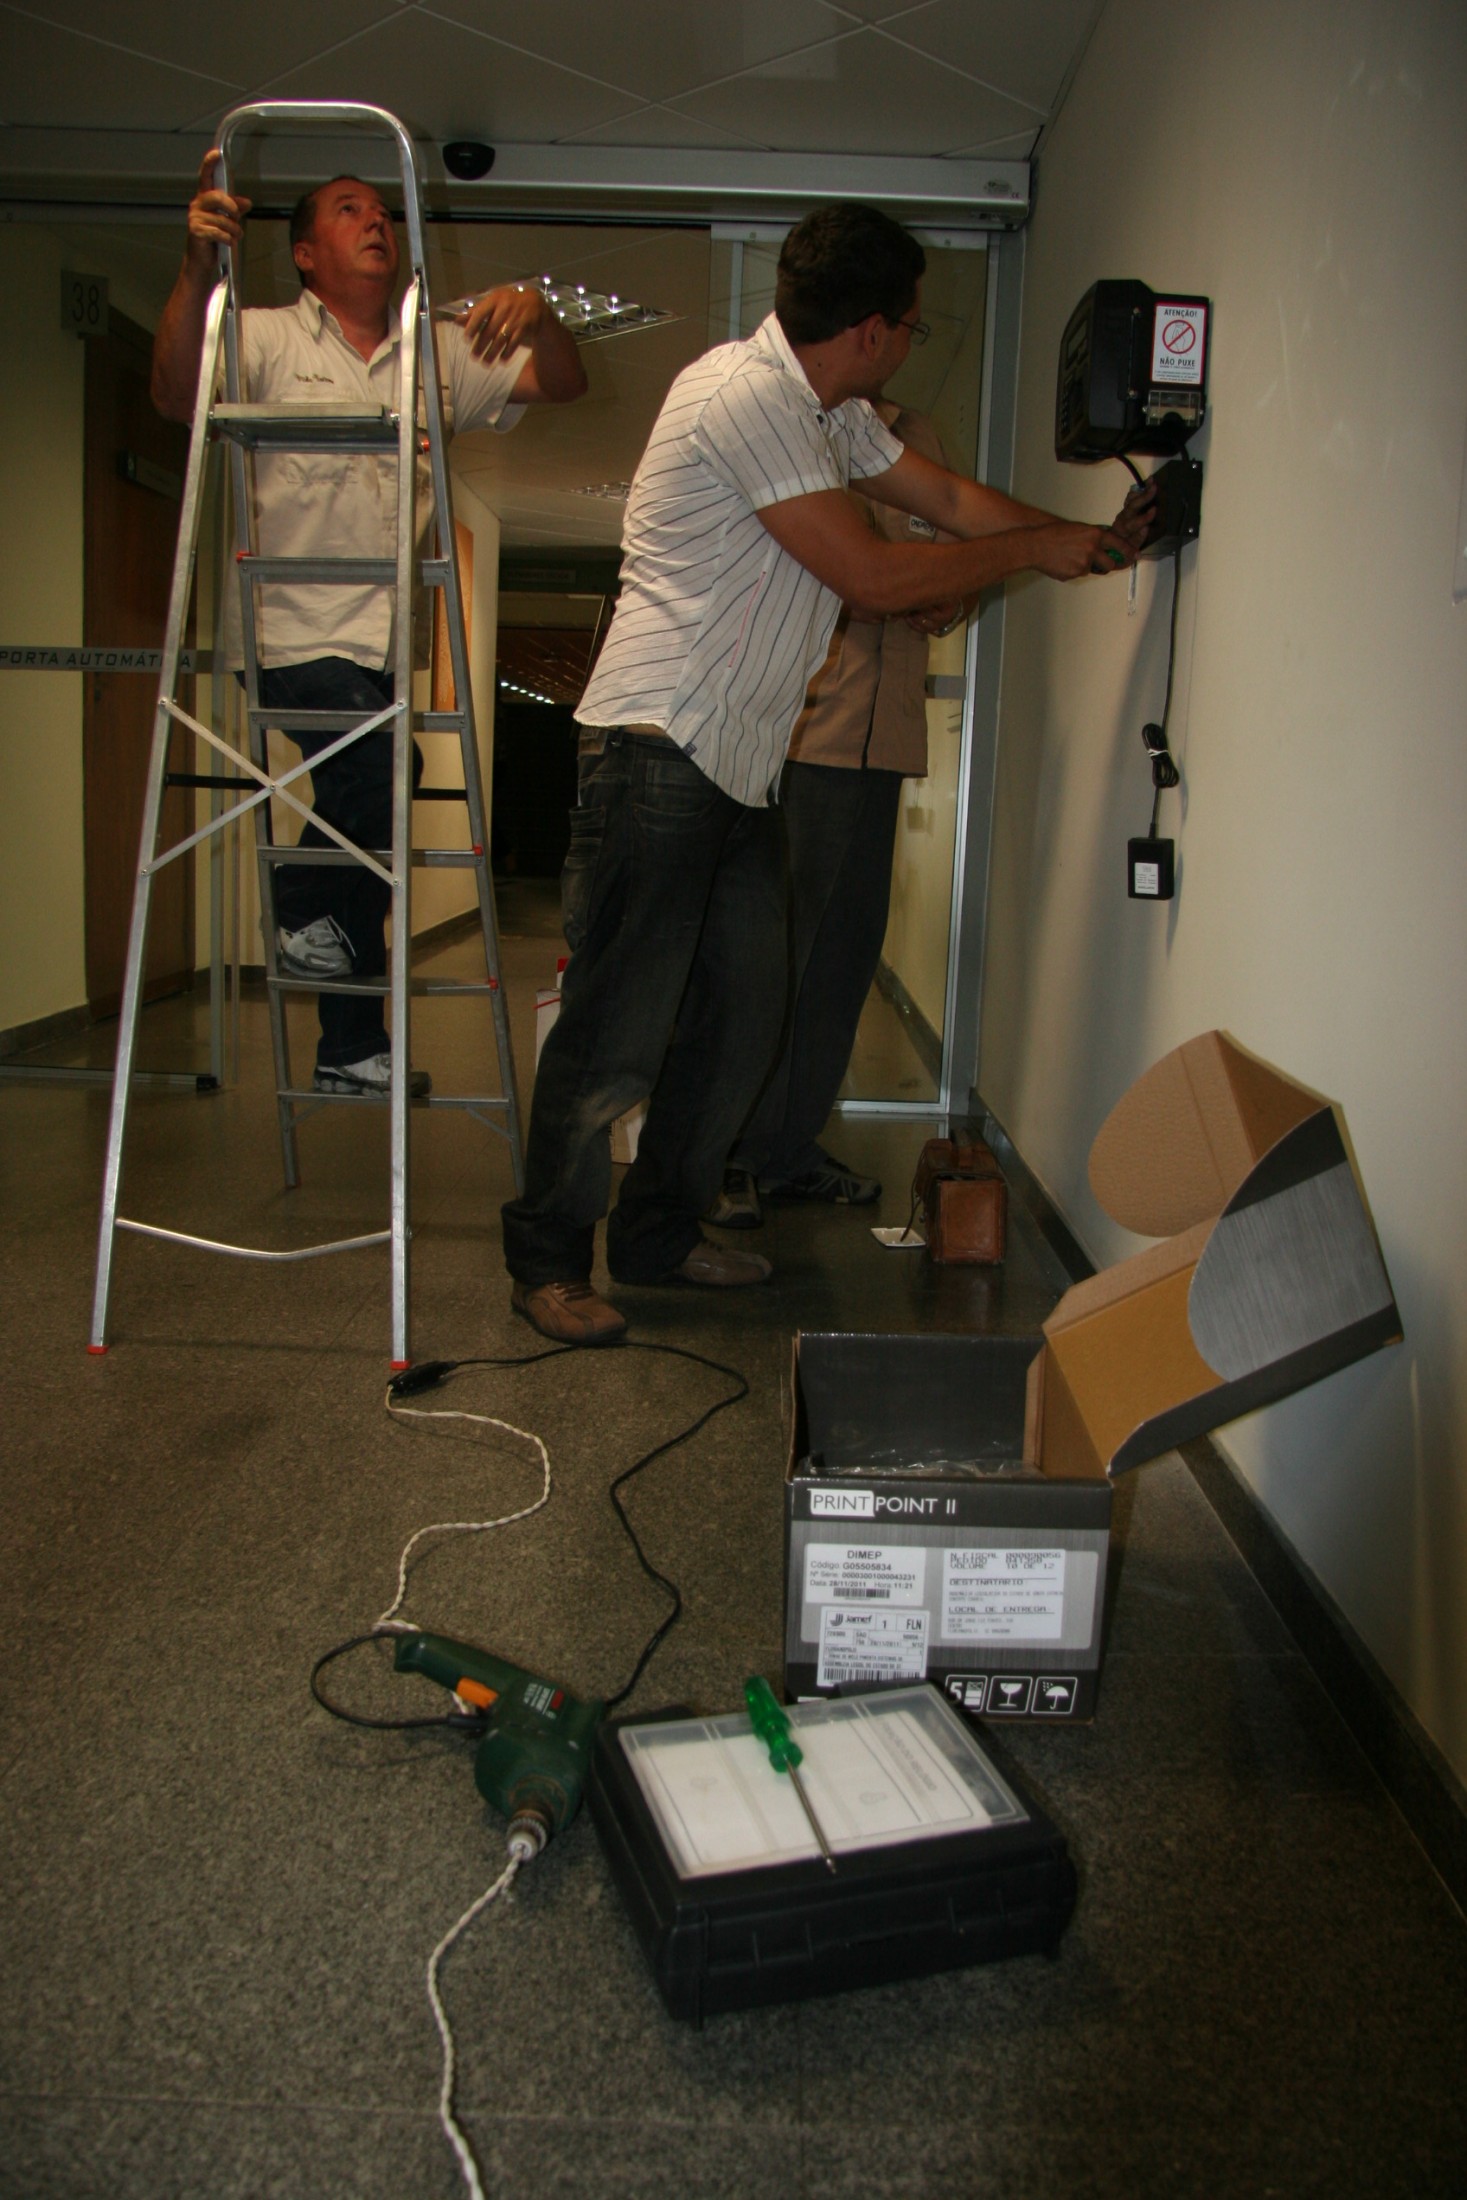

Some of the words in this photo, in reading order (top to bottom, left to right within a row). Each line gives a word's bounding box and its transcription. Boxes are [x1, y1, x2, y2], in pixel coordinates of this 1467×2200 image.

[72, 282, 99, 325] 38
[1164, 308, 1198, 319] ATENÇÃO!
[1160, 357, 1175, 366] NÃO
[1178, 359, 1195, 367] PUXE
[67, 652, 191, 668] AUTOMÁTIA
[813, 1494, 871, 1511] PRINT
[875, 1496, 938, 1514] POINT
[946, 1498, 956, 1515] II
[847, 1550, 882, 1560] DIMEP
[842, 1562, 892, 1571] G05505834
[829, 1580, 867, 1588] 28/11/2011
[882, 1620, 887, 1629] 1
[906, 1619, 922, 1630] FLN
[950, 1682, 962, 1700] 5
